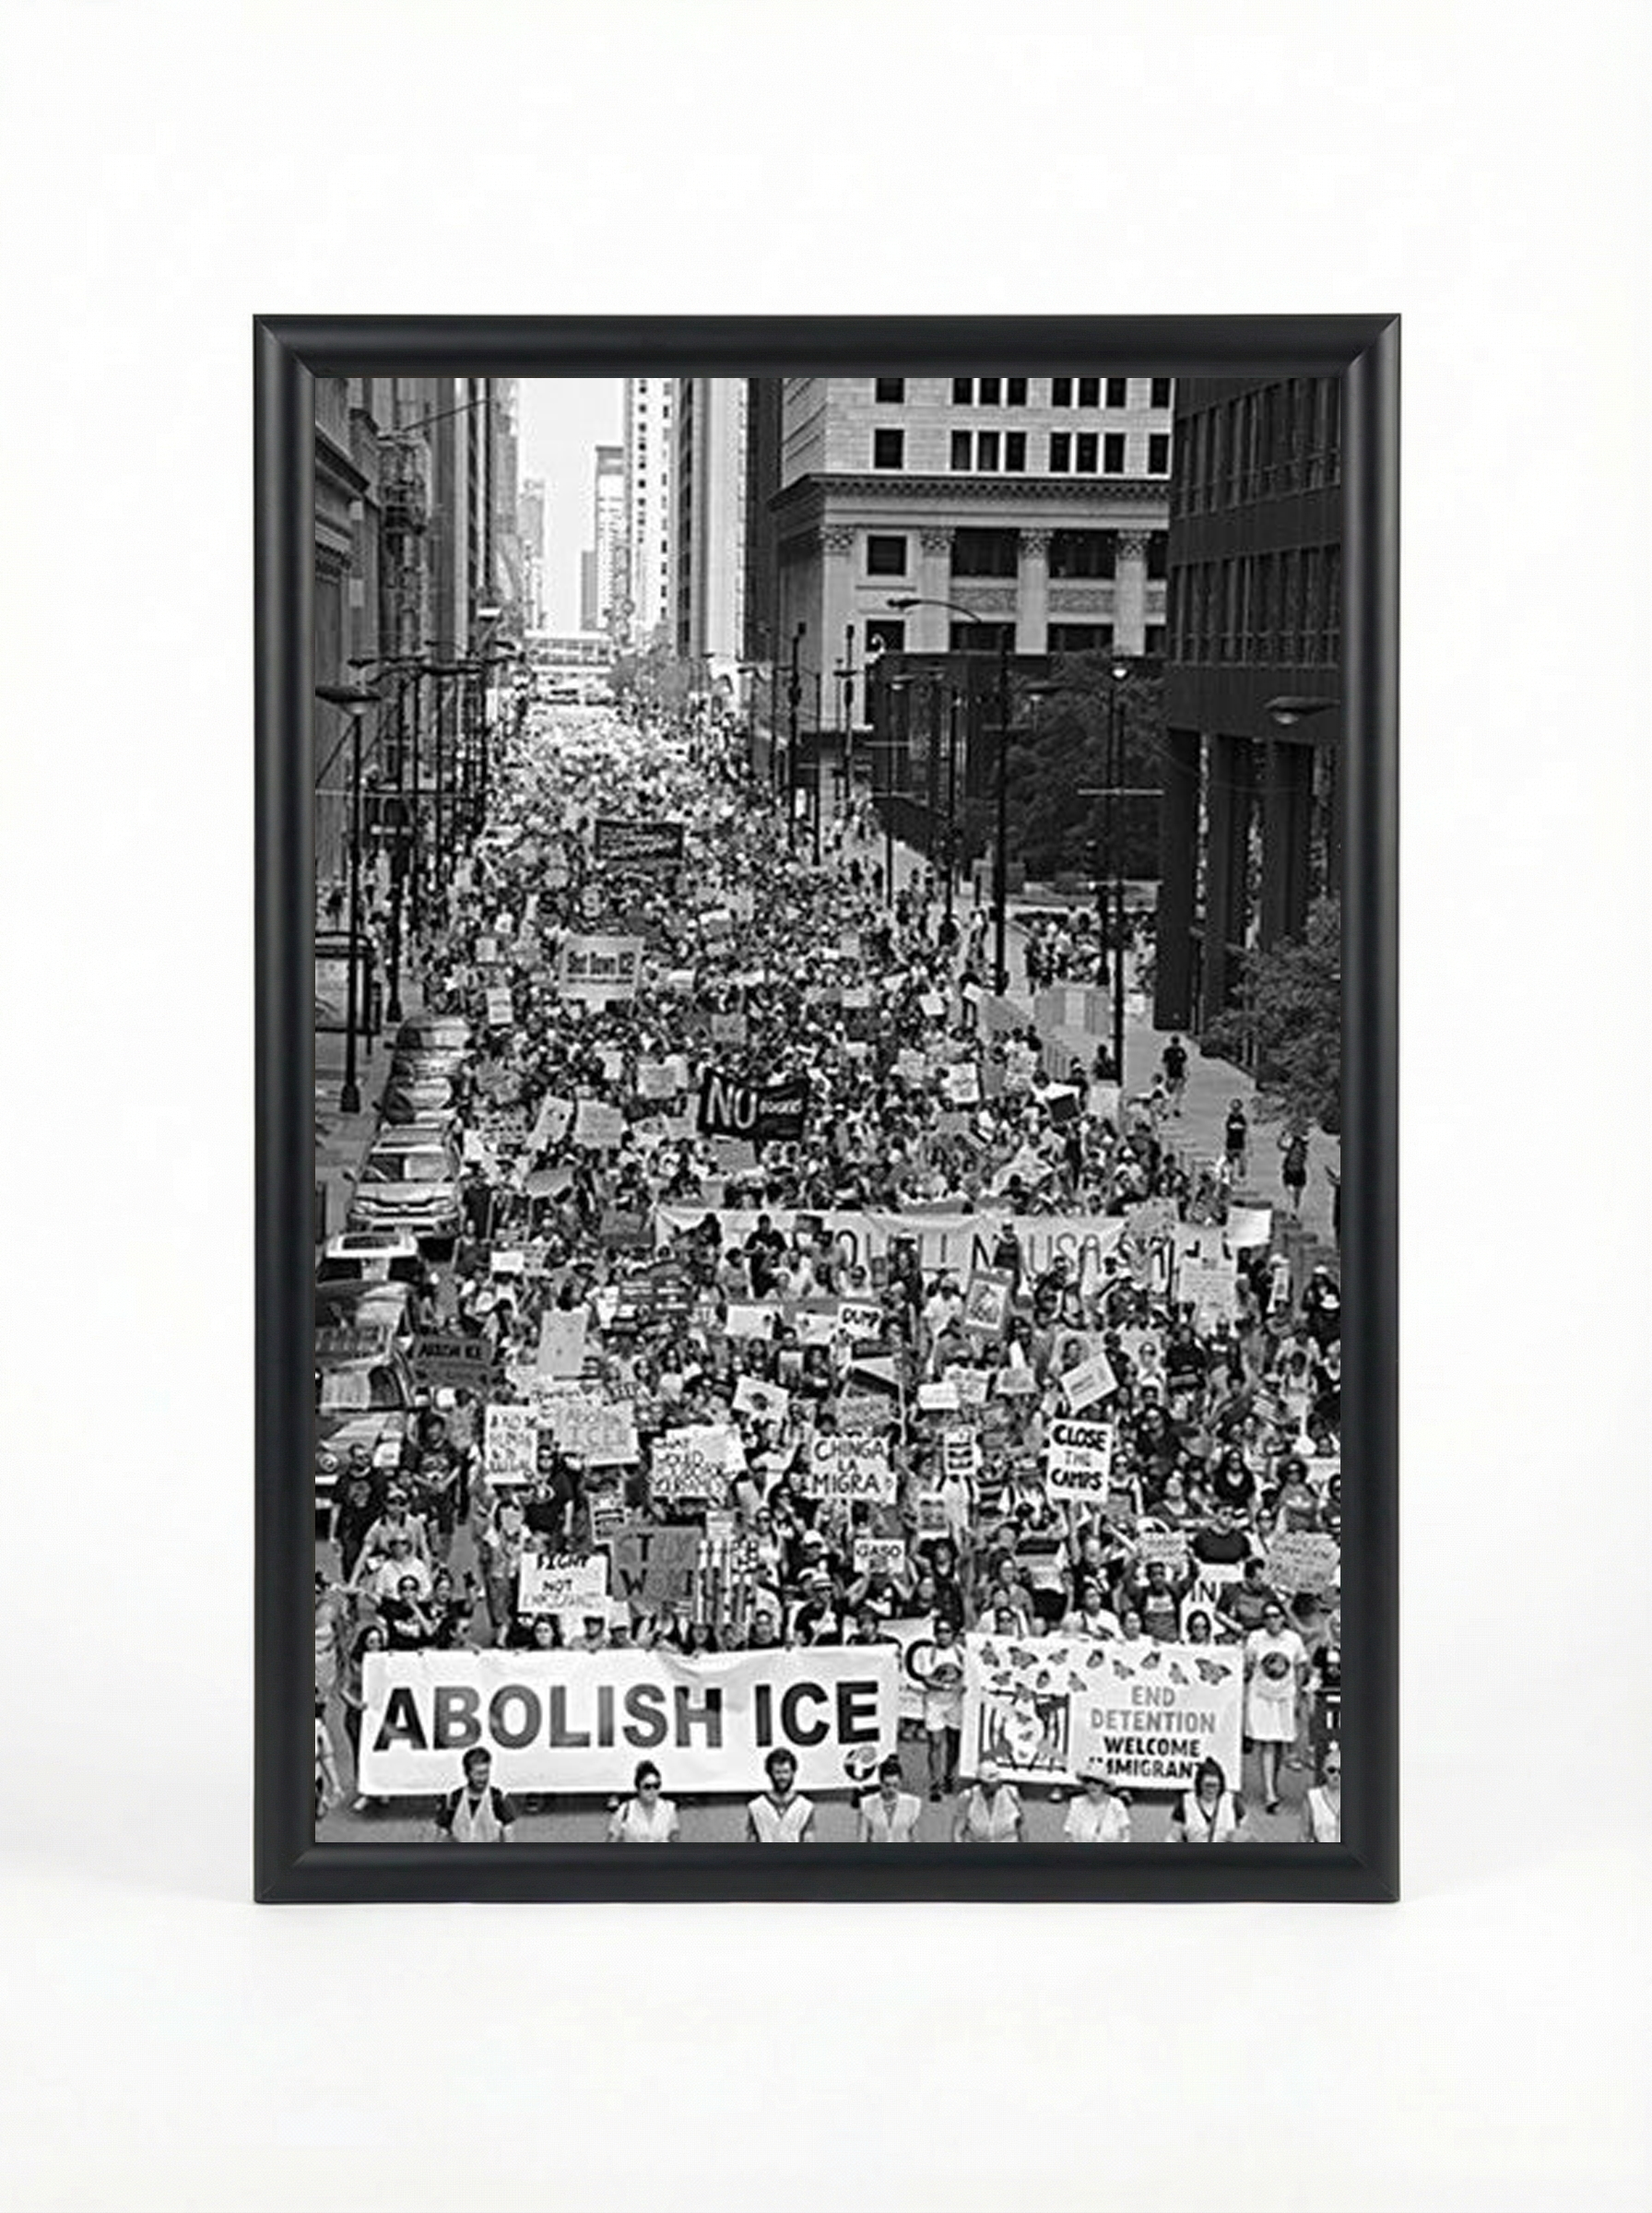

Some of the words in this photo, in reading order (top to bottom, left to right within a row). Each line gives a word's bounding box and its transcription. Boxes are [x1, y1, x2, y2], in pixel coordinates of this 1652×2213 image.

[706, 1075, 757, 1130] NO
[1053, 1424, 1107, 1451] CLOSE
[815, 1438, 887, 1462] CHINGA
[838, 1457, 858, 1473] LA
[542, 1579, 572, 1595] NOT
[1131, 1686, 1176, 1707] END
[372, 1684, 723, 1751] ABOLISH
[755, 1681, 880, 1747] ICE
[1091, 1709, 1216, 1734] DETENTION
[1103, 1736, 1201, 1757] WELCOME
